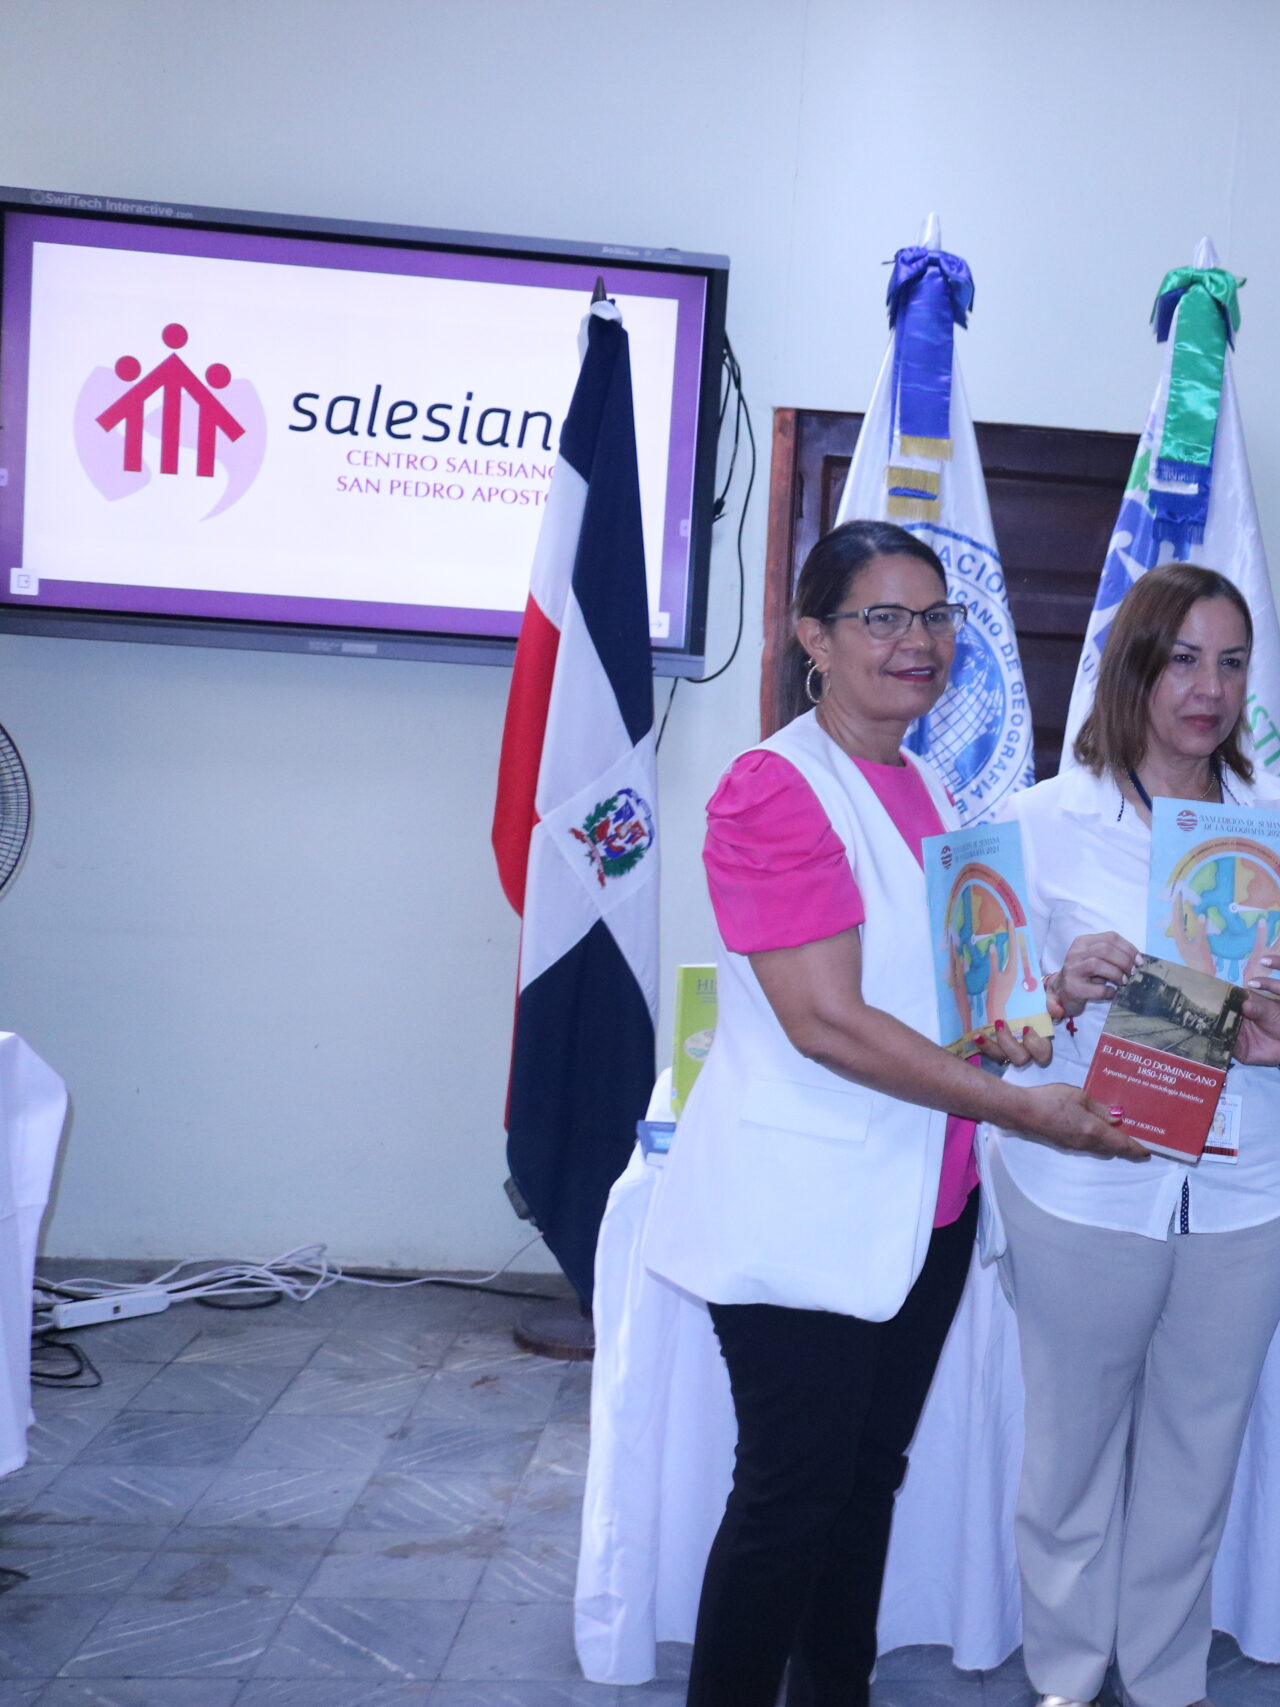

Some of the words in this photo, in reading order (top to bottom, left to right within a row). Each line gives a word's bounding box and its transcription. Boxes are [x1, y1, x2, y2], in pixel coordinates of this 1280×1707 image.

[289, 384, 552, 451] salesian
[346, 449, 438, 472] CENTRO
[336, 475, 381, 494] SAN
[390, 479, 464, 500] PEDRO
[472, 486, 550, 506] APOST
[1000, 643, 1021, 672] DE
[1102, 1045, 1114, 1055] EL
[1115, 1048, 1152, 1066] PUEBLO
[1152, 1060, 1217, 1088] DOMINICANO
[1103, 1067, 1127, 1079] Apuntes
[1128, 1075, 1141, 1084] para
[1137, 1066, 1177, 1085] 1850-1900
